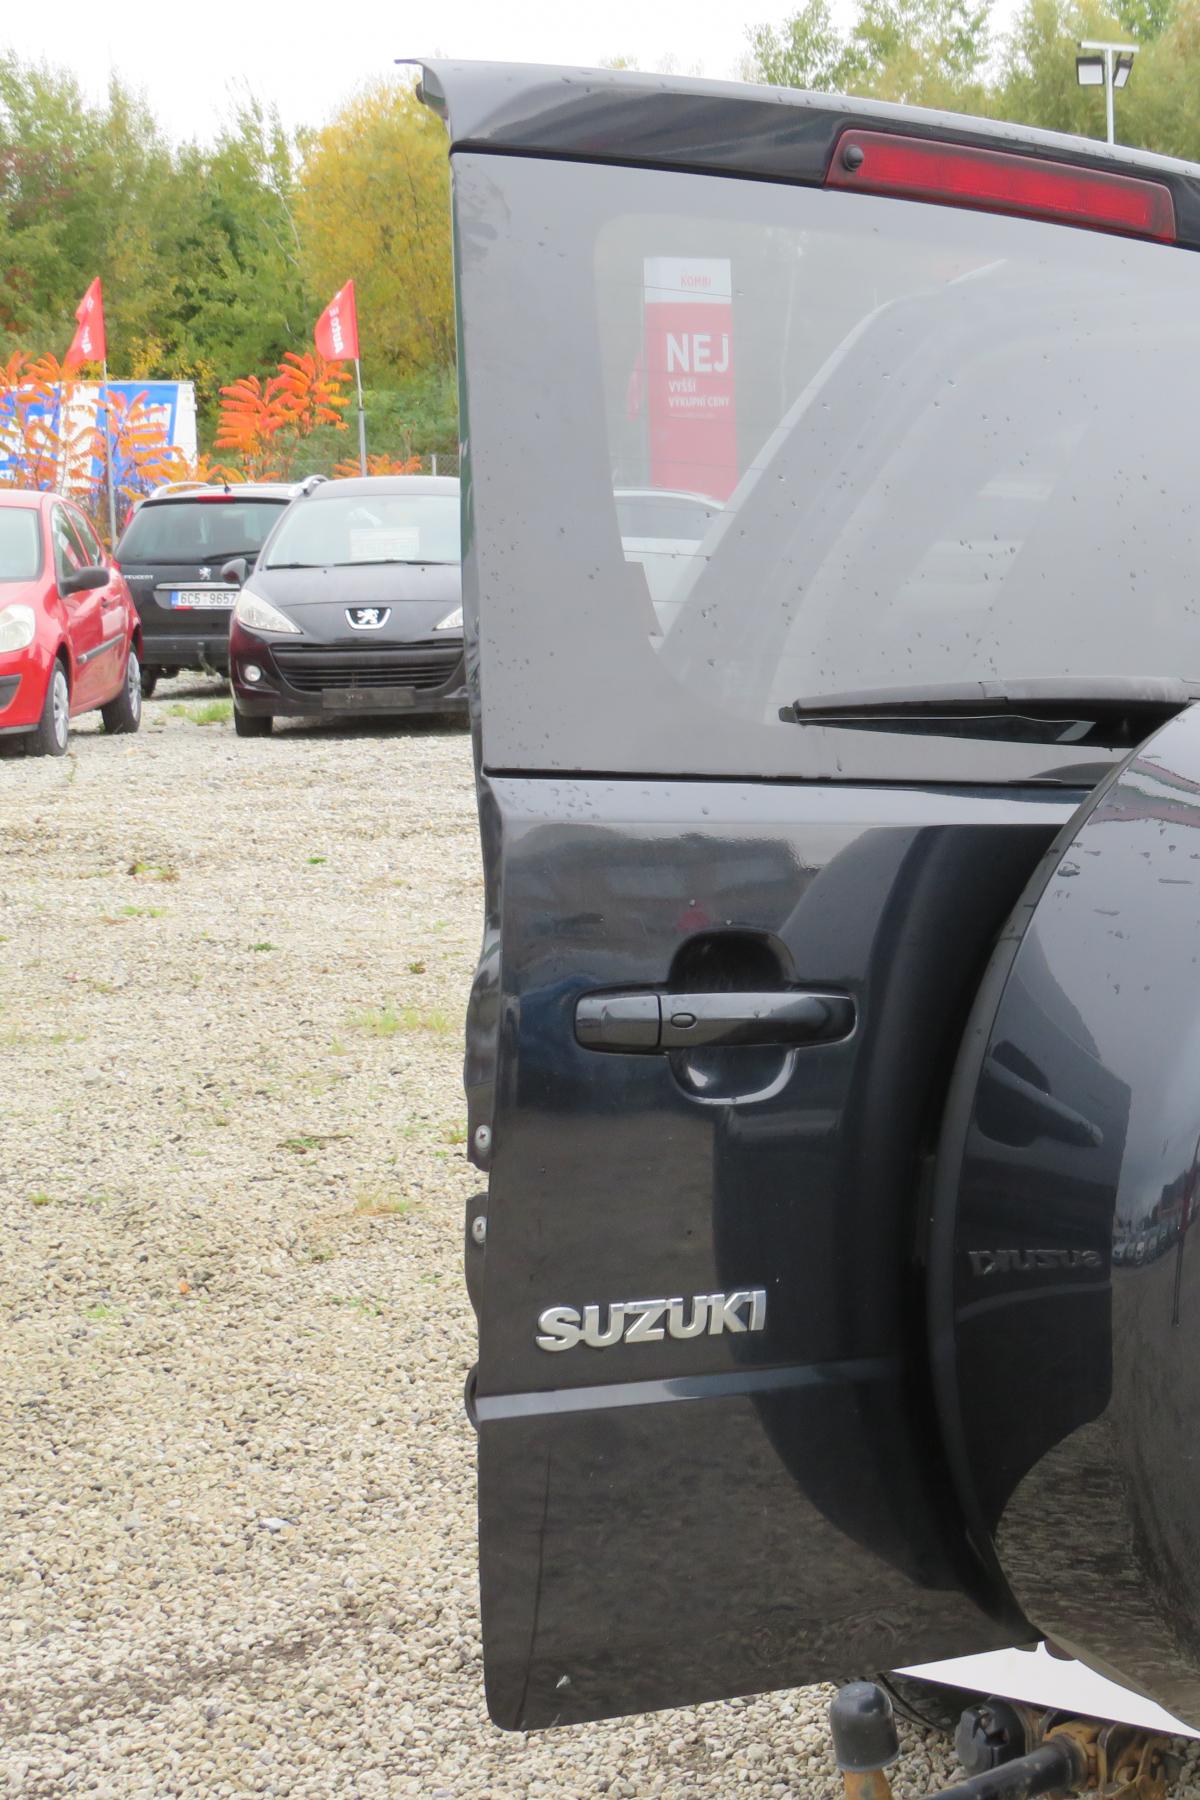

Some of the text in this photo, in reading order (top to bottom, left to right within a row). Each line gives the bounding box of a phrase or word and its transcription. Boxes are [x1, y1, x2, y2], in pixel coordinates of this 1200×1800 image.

[681, 274, 712, 288] KOMBI
[666, 333, 729, 373] NEJ
[707, 395, 730, 408] CENY
[180, 592, 201, 605] 6C5
[208, 592, 237, 605] 9657
[535, 1289, 768, 1352] SUZUKI
